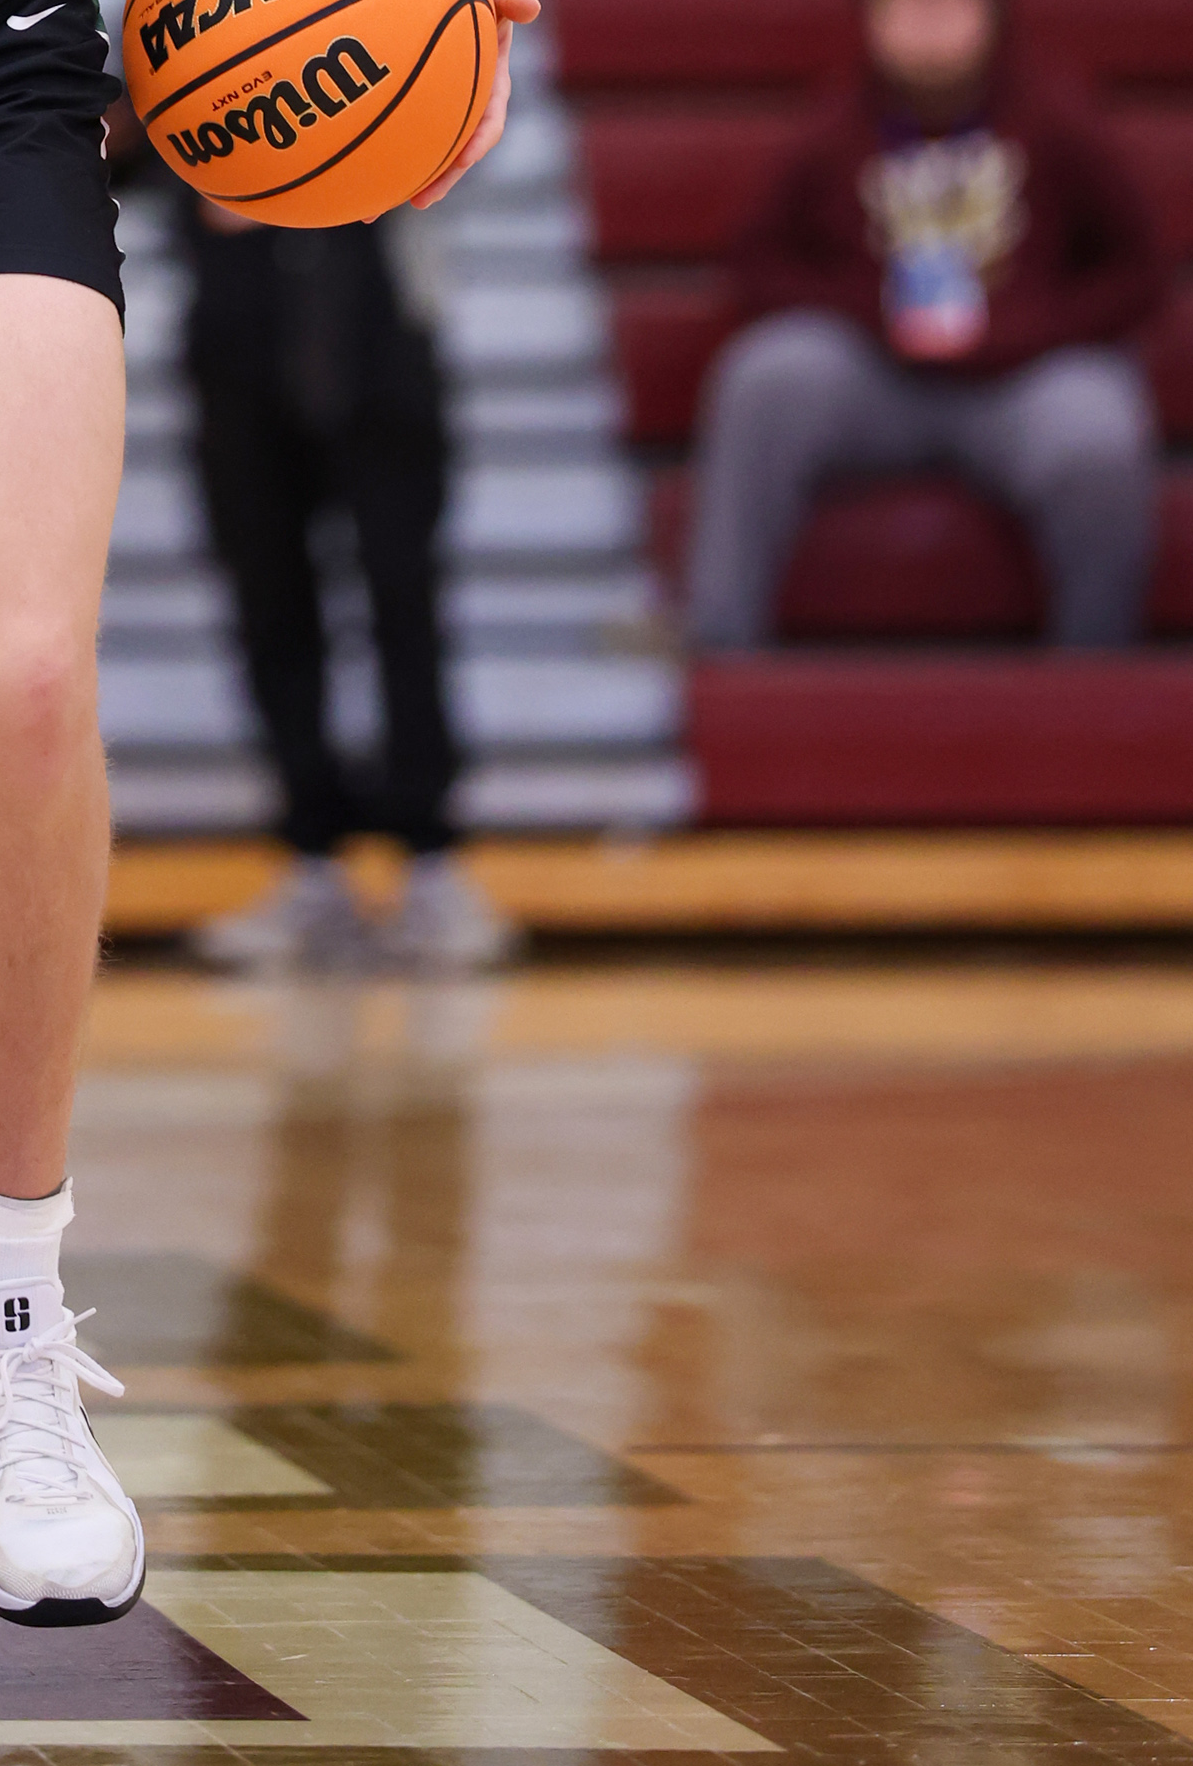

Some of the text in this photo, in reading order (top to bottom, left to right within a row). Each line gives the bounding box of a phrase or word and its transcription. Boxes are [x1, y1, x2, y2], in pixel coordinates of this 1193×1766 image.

[167, 35, 392, 168] Wilson
[211, 70, 273, 112] EVO NXT
